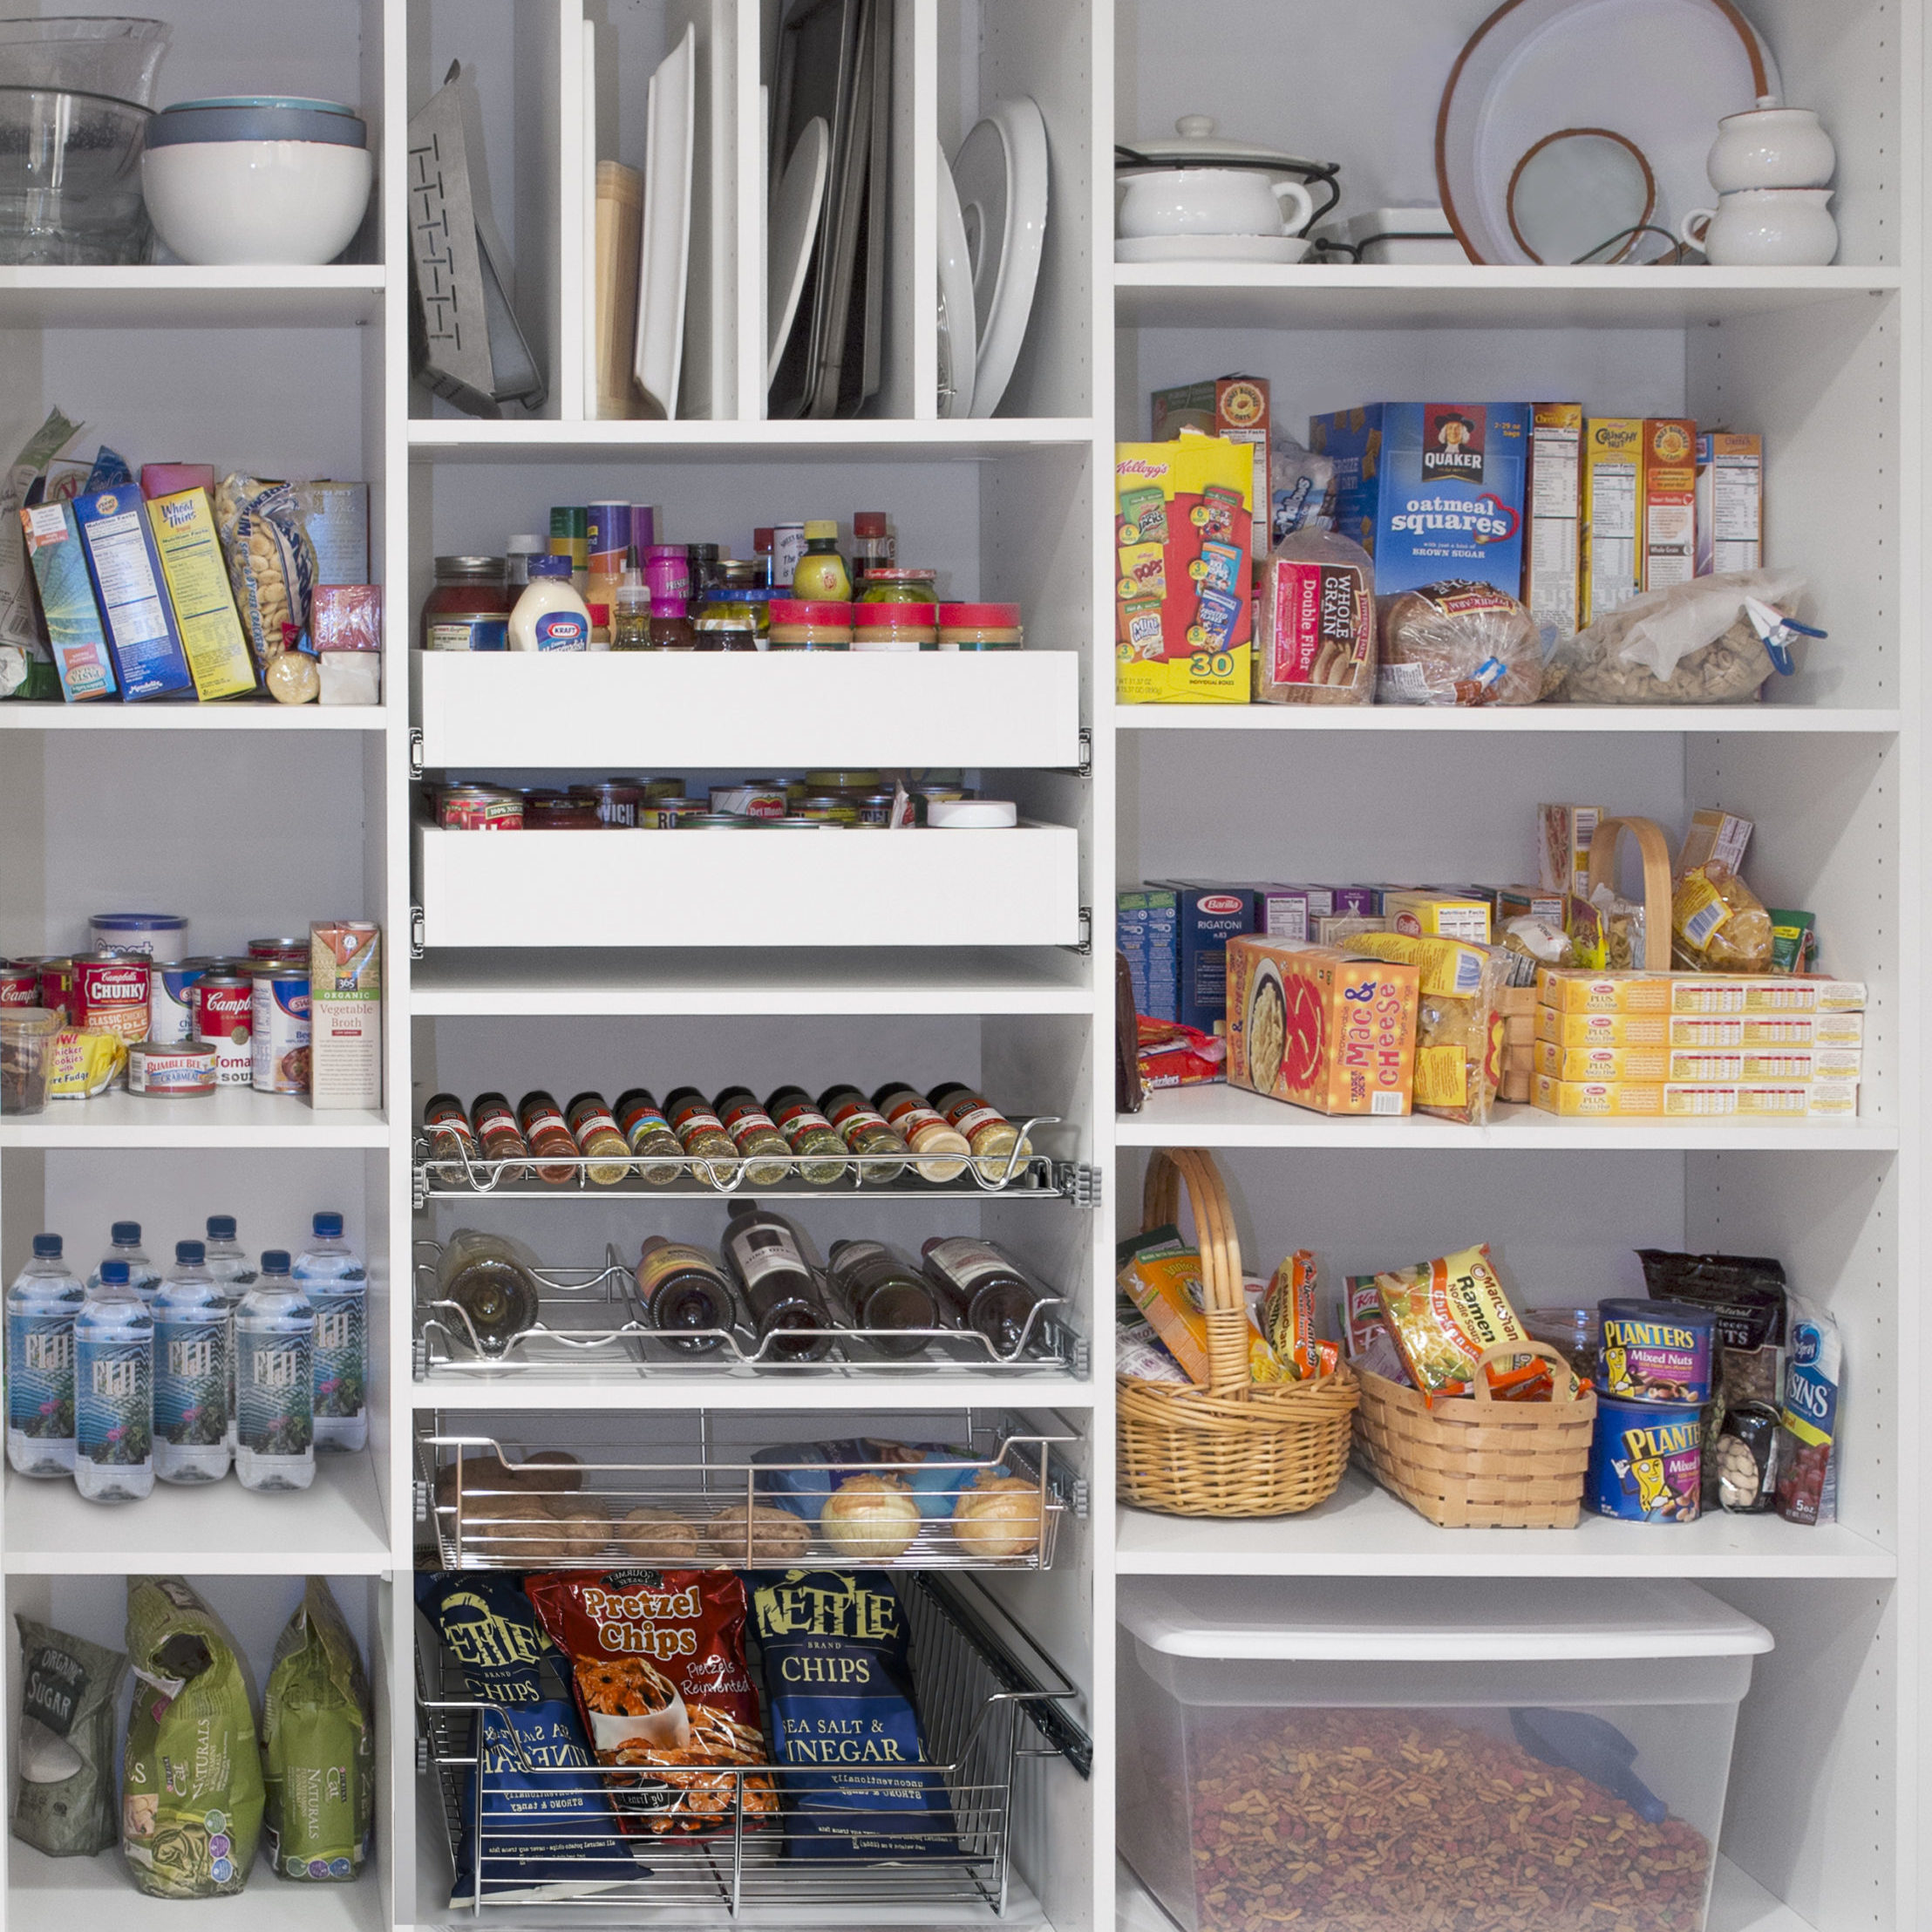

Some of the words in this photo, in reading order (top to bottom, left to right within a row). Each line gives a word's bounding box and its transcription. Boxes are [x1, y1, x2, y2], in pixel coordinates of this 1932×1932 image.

[1595, 427, 1637, 445] CRUNCHY
[1608, 439, 1625, 449] NUT
[1117, 459, 1169, 478] Kellogg's
[1424, 452, 1482, 469] QUAKER
[160, 500, 194, 518] Wheat
[1406, 497, 1494, 516] oatmeal
[162, 510, 197, 527] Thins
[1391, 514, 1507, 536] squares
[1412, 548, 1449, 556] BROWN
[1451, 549, 1486, 559] SUGAR
[1301, 579, 1317, 630] Double
[1323, 576, 1338, 636] GRAIN
[1335, 574, 1351, 638] WHOLE
[554, 626, 577, 635] KRAFT
[1189, 650, 1235, 677] 30
[1299, 634, 1314, 671] Fiber
[1206, 899, 1240, 910] Barilla
[1197, 920, 1242, 930] RIGATONI
[91, 982, 146, 1000] CHUNKY
[339, 978, 355, 989] 365
[1344, 981, 1378, 1003] &
[88, 1014, 122, 1026] CLASSIC
[320, 1003, 373, 1016] Vegetable
[331, 1017, 362, 1028] Broth
[1345, 1008, 1375, 1068] Mac
[146, 1058, 186, 1075] BUMBLE
[1457, 1276, 1496, 1344] Ramen
[1466, 1320, 1481, 1344] Soup
[1604, 1320, 1696, 1350] PLANTERS
[24, 1334, 69, 1369] FIJI
[168, 1340, 211, 1376] FIJI
[1630, 1350, 1666, 1364] Mixed
[1668, 1353, 1693, 1366] Nuts
[92, 1360, 136, 1395] FIJI
[254, 1351, 296, 1385] FIJI
[1669, 1458, 1697, 1473] Mixed
[582, 1585, 703, 1619] Pretzel
[599, 1620, 698, 1660] Chips
[807, 1642, 842, 1650] BRAND
[41, 1650, 83, 1684] ORGANIC
[485, 1670, 512, 1678] BRAND
[686, 1655, 736, 1677] Pretzels
[781, 1656, 871, 1684] CHIPS
[28, 1670, 72, 1719] SUGAR
[464, 1677, 541, 1703] CHIPS
[681, 1678, 751, 1697] Reinvented
[817, 1719, 863, 1735] SALT
[871, 1719, 884, 1733] &
[192, 1718, 211, 1801] NATURALS
[786, 1738, 906, 1764] INEGAR
[173, 1762, 187, 1798] Cat
[326, 1765, 341, 1799] Cat
[307, 1768, 321, 1840] NATURALS
